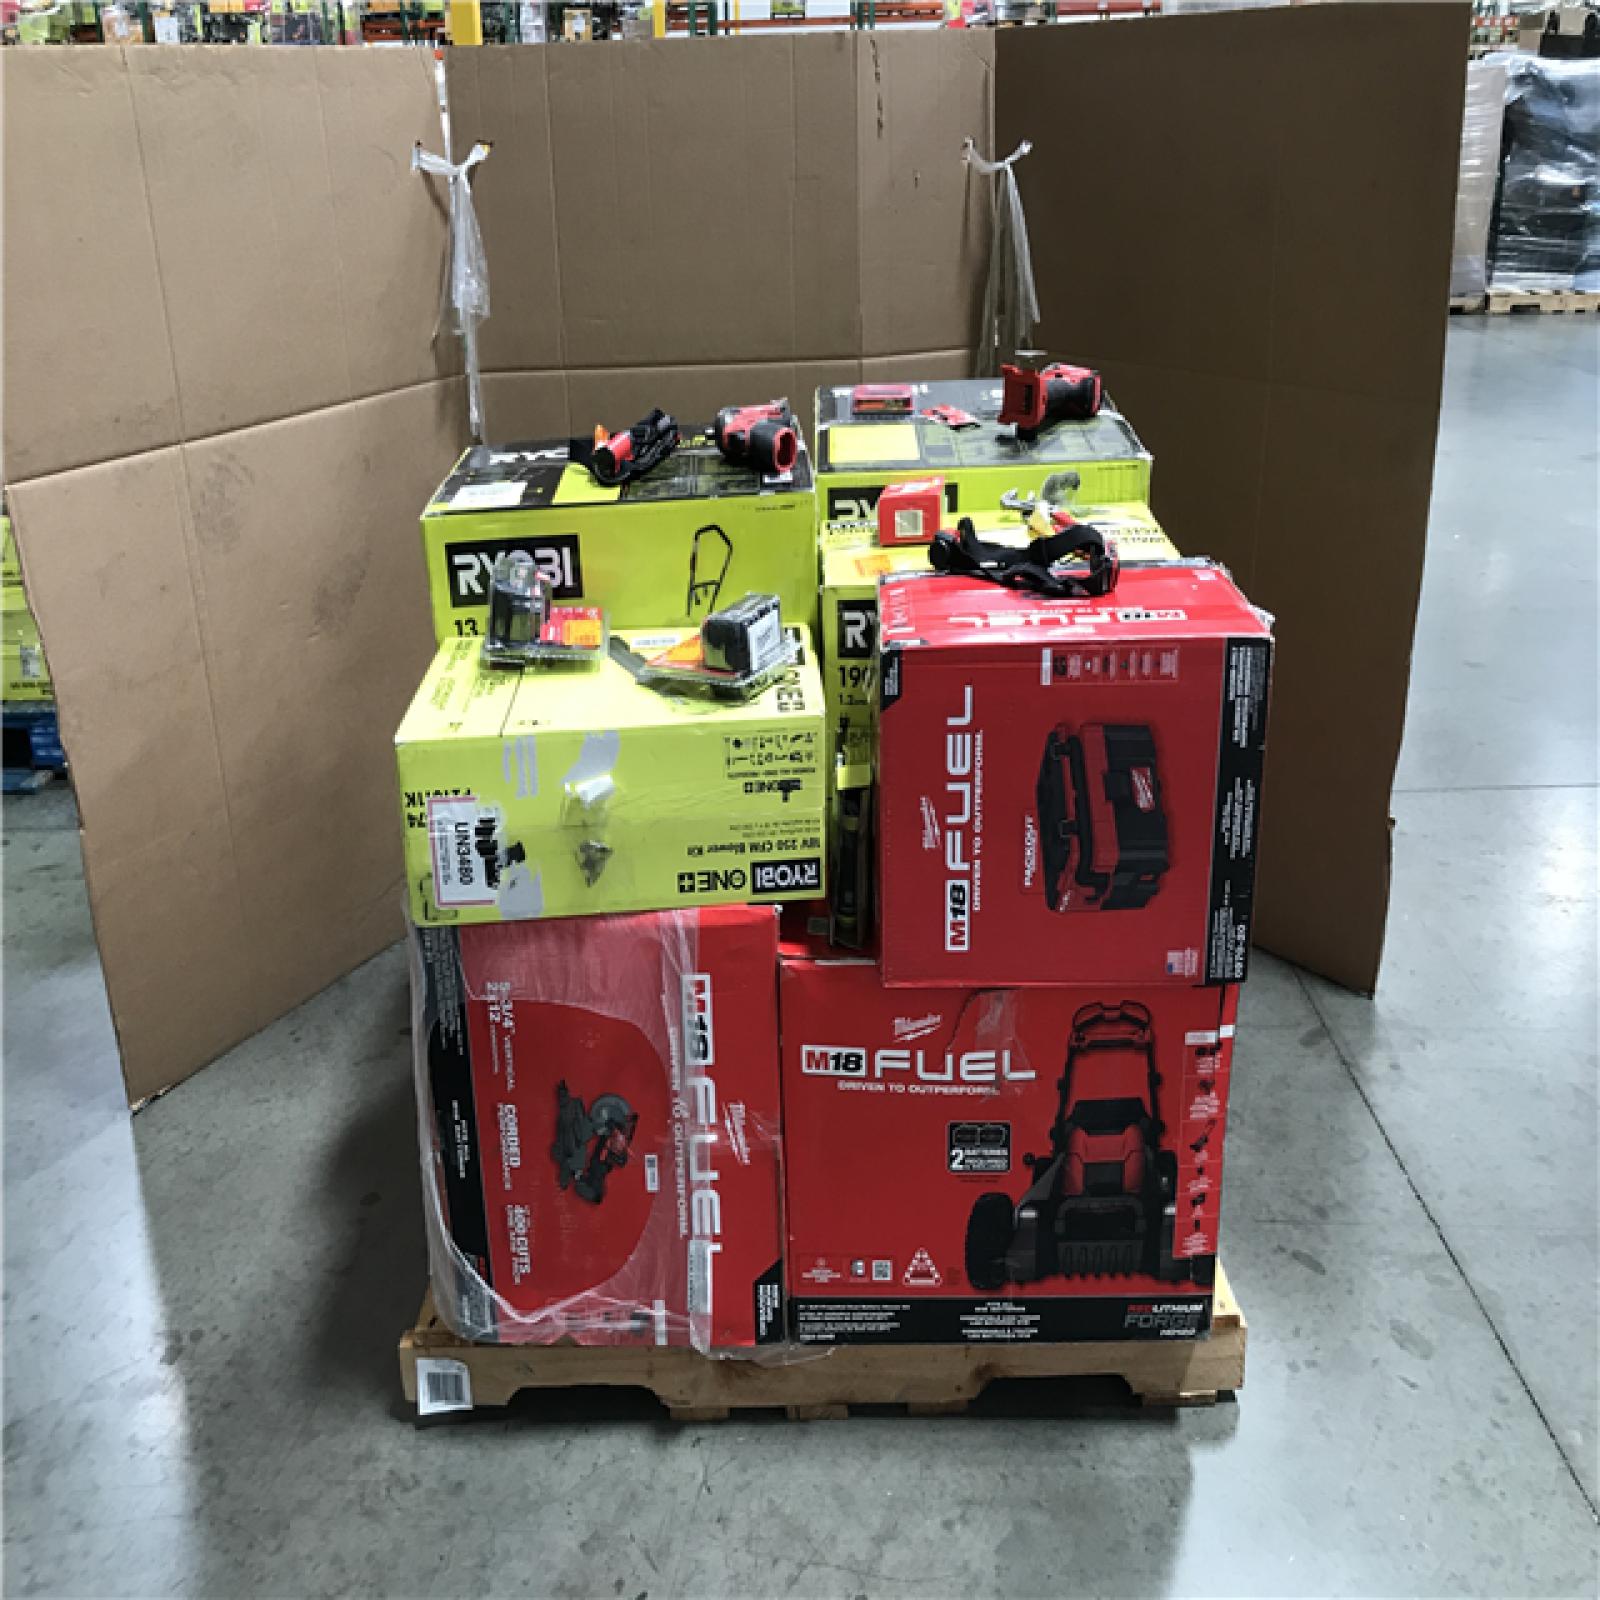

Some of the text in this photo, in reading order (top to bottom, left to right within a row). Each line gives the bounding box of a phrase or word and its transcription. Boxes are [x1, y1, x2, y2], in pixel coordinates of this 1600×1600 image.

[946, 684, 973, 949] M18 FUEL
[455, 821, 474, 886] UN3480
[755, 863, 819, 889] RYOBI
[804, 1048, 1036, 1081] M18 FUEL
[890, 1083, 905, 1094] TO
[952, 1150, 966, 1170] 2
[687, 1077, 722, 1315] FUEL
